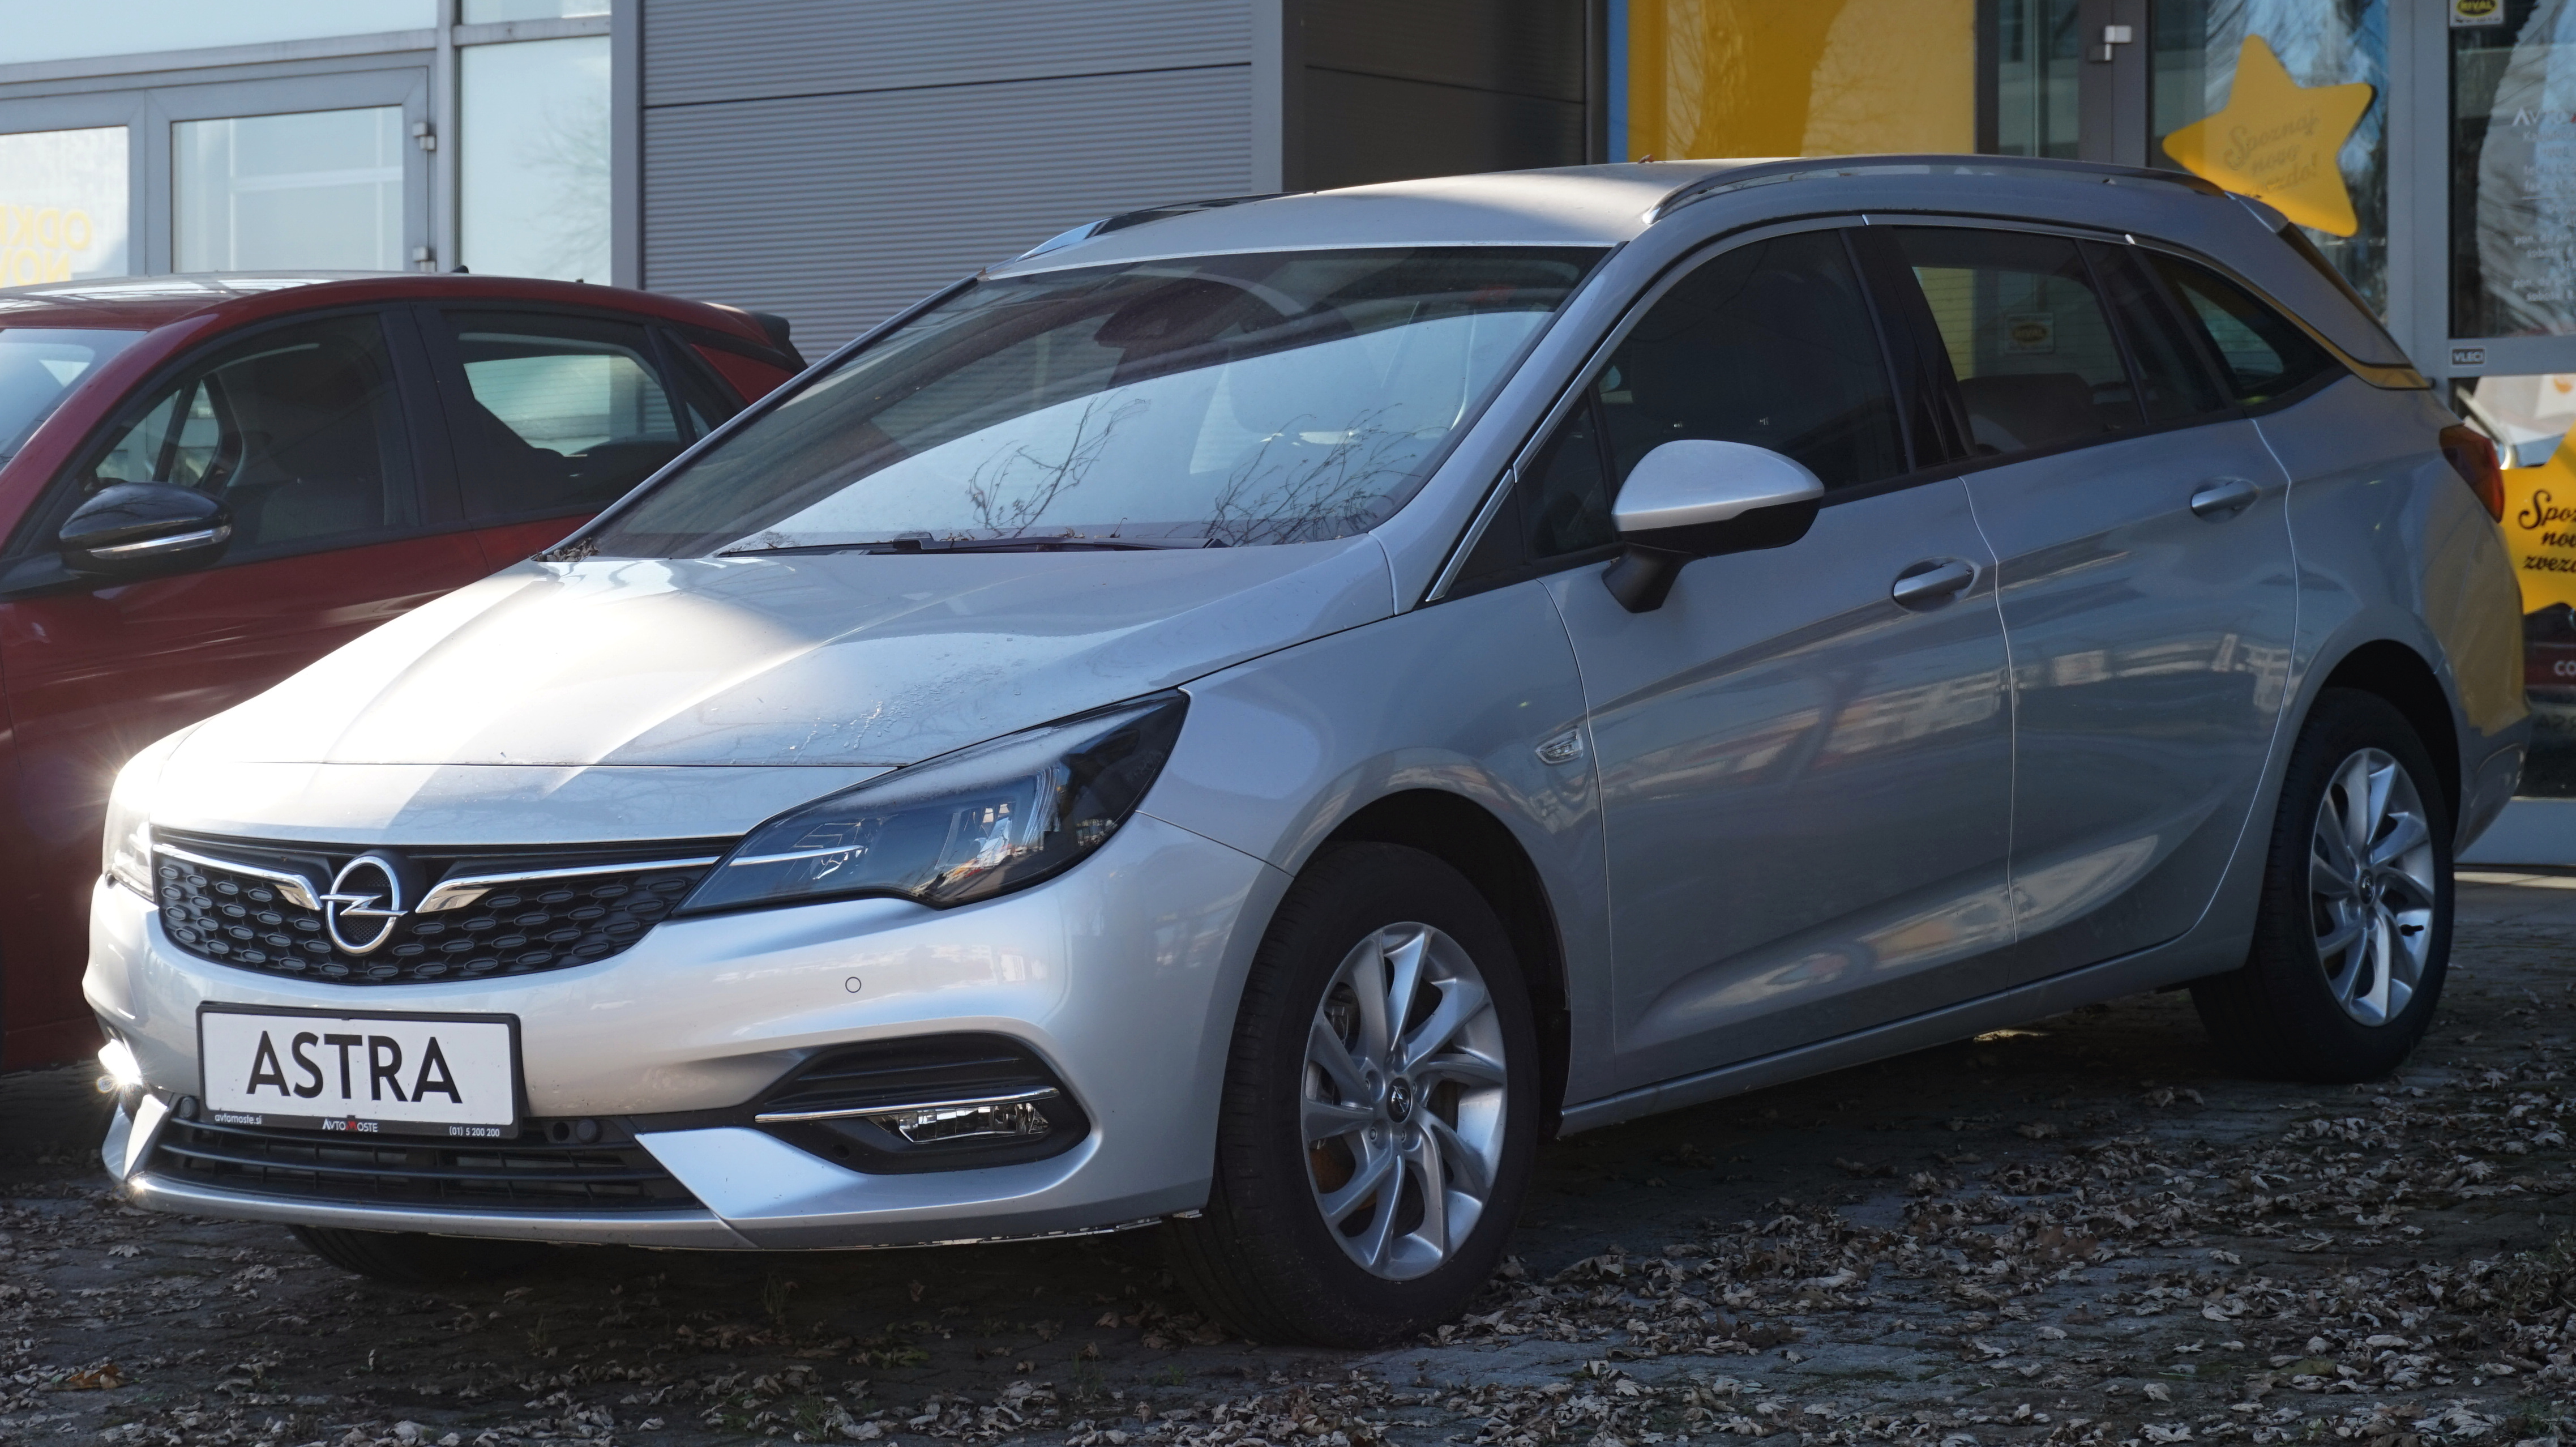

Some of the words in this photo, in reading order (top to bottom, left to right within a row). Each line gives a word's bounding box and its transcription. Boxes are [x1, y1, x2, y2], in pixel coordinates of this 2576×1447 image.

[246, 1030, 463, 1104] ASTRA
[215, 1113, 262, 1125] avtomoste.si
[449, 1125, 463, 1136] (01)
[465, 1127, 470, 1136] 5
[472, 1128, 485, 1137] 200
[486, 1128, 499, 1137] 200
